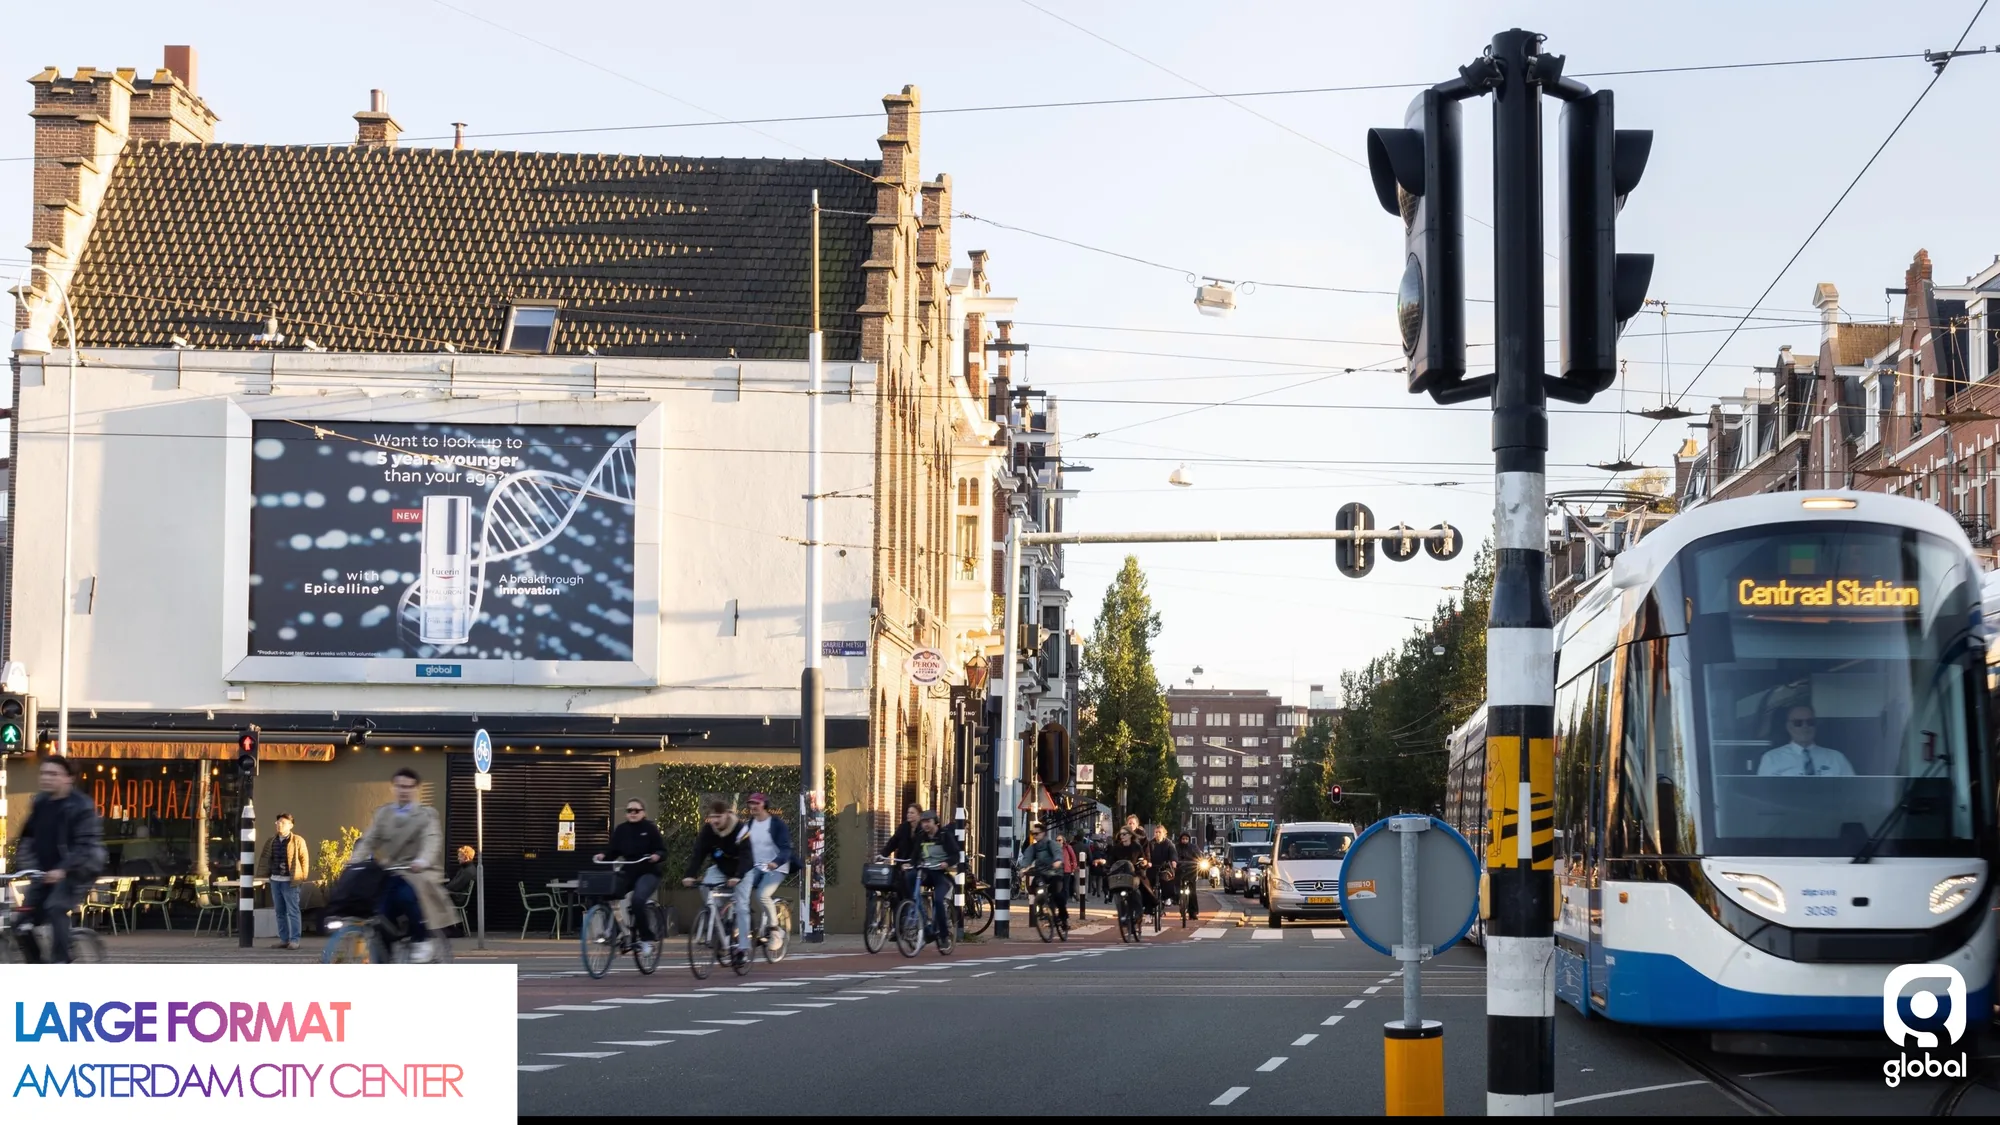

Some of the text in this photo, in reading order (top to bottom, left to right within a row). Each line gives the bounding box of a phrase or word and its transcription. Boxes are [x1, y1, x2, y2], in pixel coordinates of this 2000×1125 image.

[374, 433, 523, 451] Want to look up to
[376, 451, 519, 469] 5 years younger
[384, 469, 421, 482] than
[424, 471, 462, 486] your
[396, 512, 420, 520] NEW
[346, 570, 380, 581] with
[431, 567, 460, 575] Eucerin
[498, 573, 584, 586] A breakthrough
[499, 584, 560, 596] innovation
[1739, 579, 1919, 606] Centraal Station
[425, 665, 452, 676] global
[1362, 880, 1371, 888] 10
